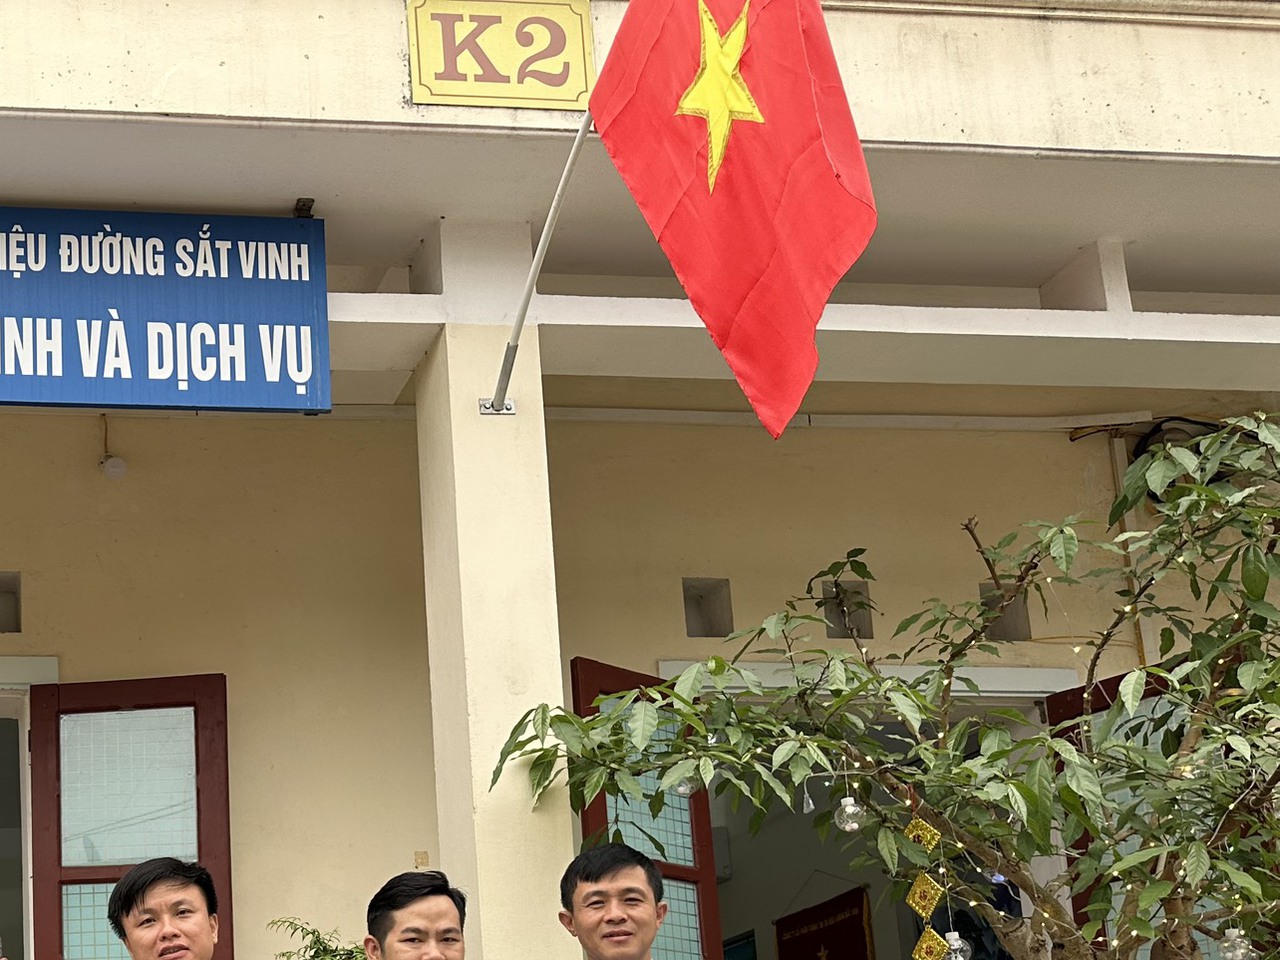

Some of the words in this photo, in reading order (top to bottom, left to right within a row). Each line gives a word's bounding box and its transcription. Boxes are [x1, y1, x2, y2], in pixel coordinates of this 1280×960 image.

[431, 12, 570, 87] K2
[59, 224, 165, 277] ĐƯỜNG
[176, 224, 232, 279] SẮT
[238, 241, 310, 282] VINH
[77, 309, 133, 379] VÀ
[147, 322, 247, 391] DỊCH
[259, 325, 313, 395] VỤ
